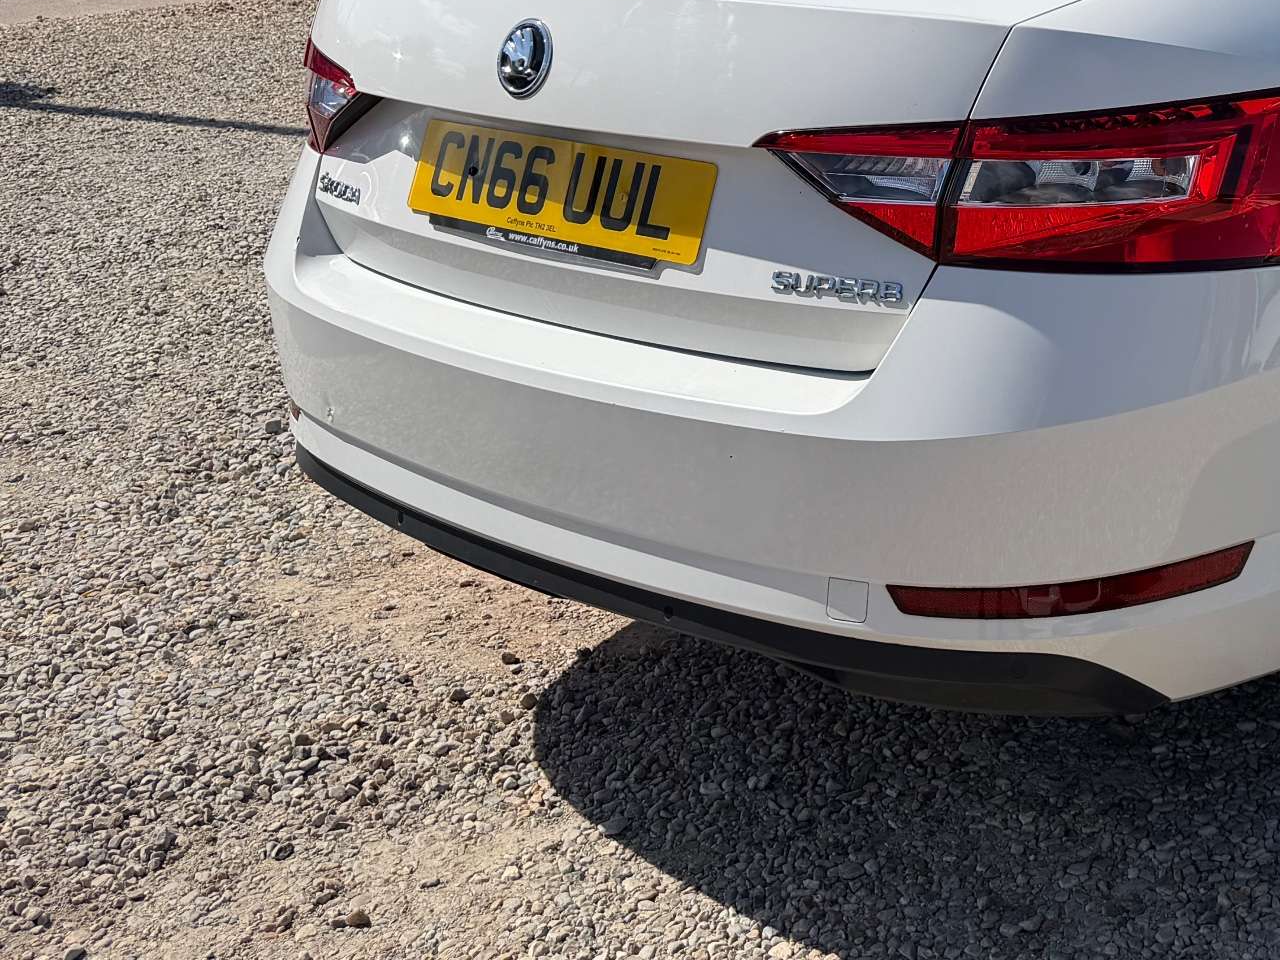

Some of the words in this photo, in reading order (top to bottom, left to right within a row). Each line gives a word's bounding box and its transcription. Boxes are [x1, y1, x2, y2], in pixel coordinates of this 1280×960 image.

[430, 130, 556, 216] CN66
[562, 151, 671, 240] UUL
[508, 232, 579, 253] www.caffyns.co.uk
[771, 270, 903, 303] SUPERB
